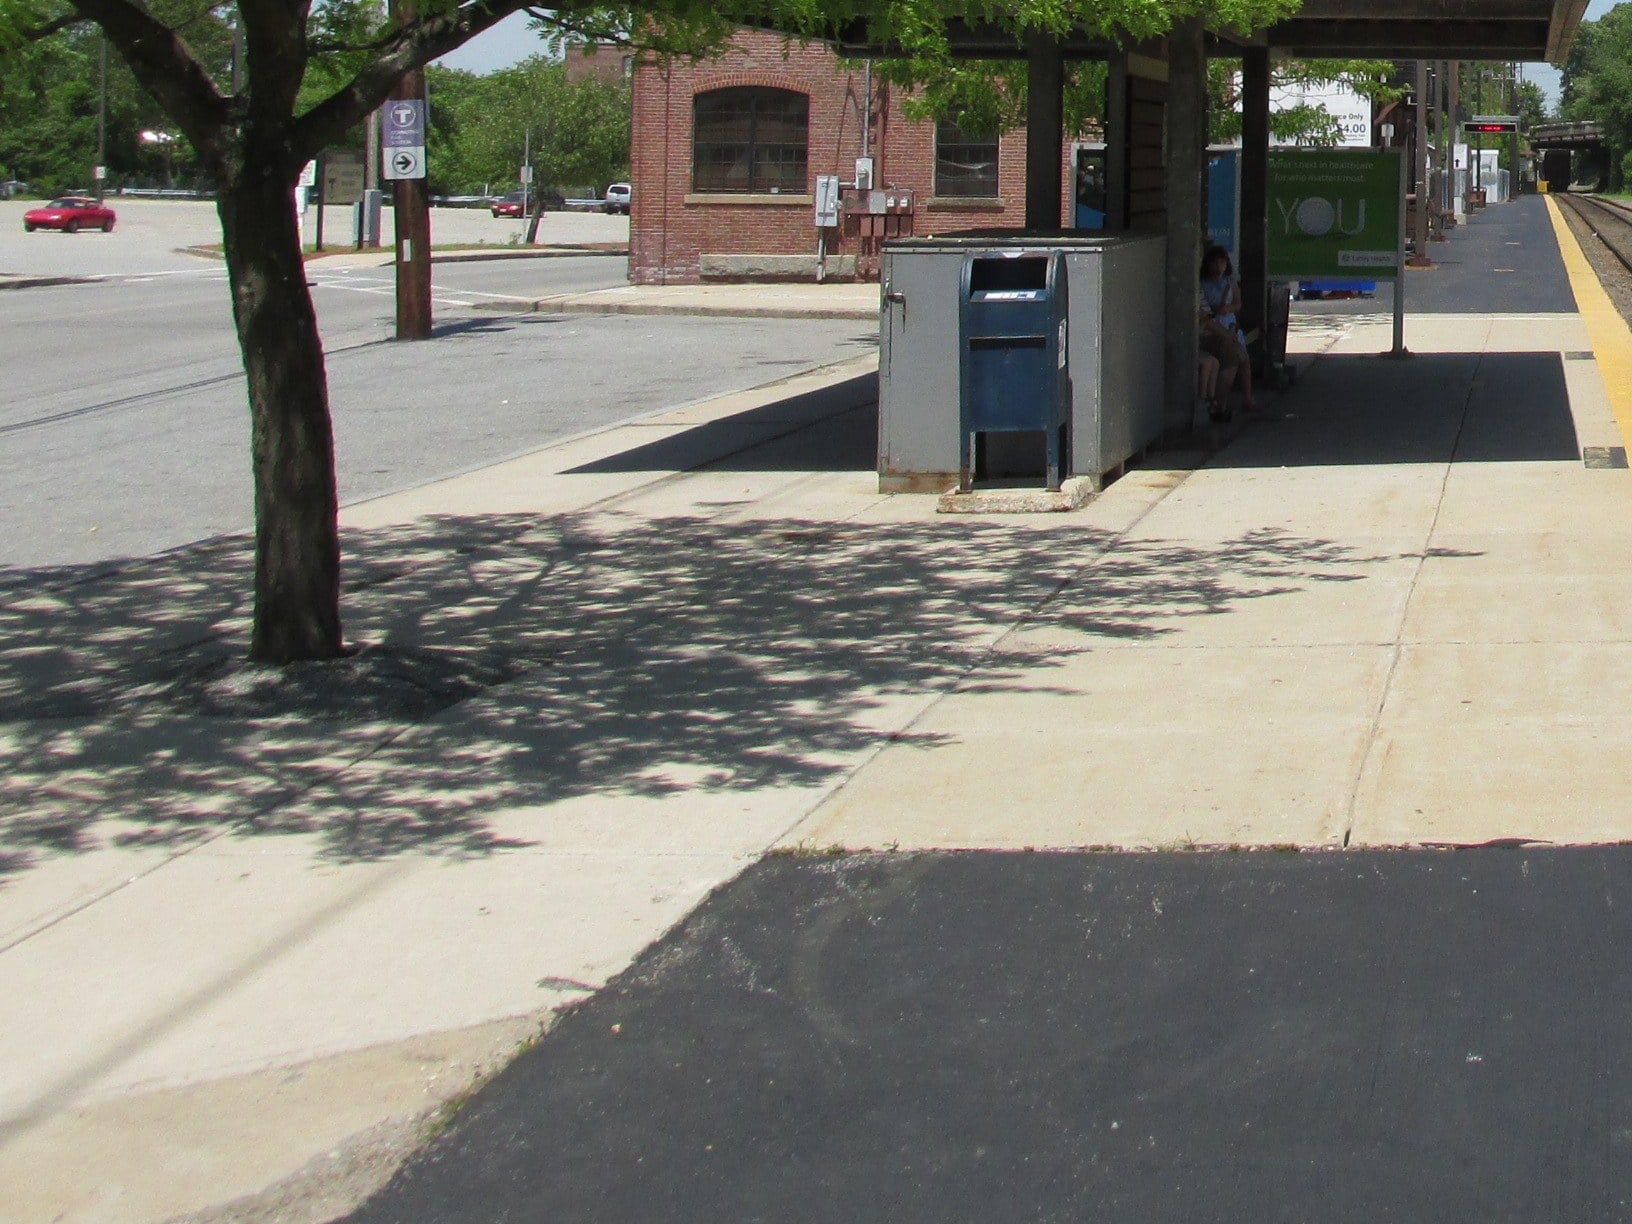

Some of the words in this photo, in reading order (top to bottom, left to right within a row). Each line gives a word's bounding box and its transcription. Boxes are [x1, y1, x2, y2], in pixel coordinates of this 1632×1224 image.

[394, 109, 411, 123] T
[1349, 113, 1364, 121] Only
[1276, 197, 1366, 235] YOU
